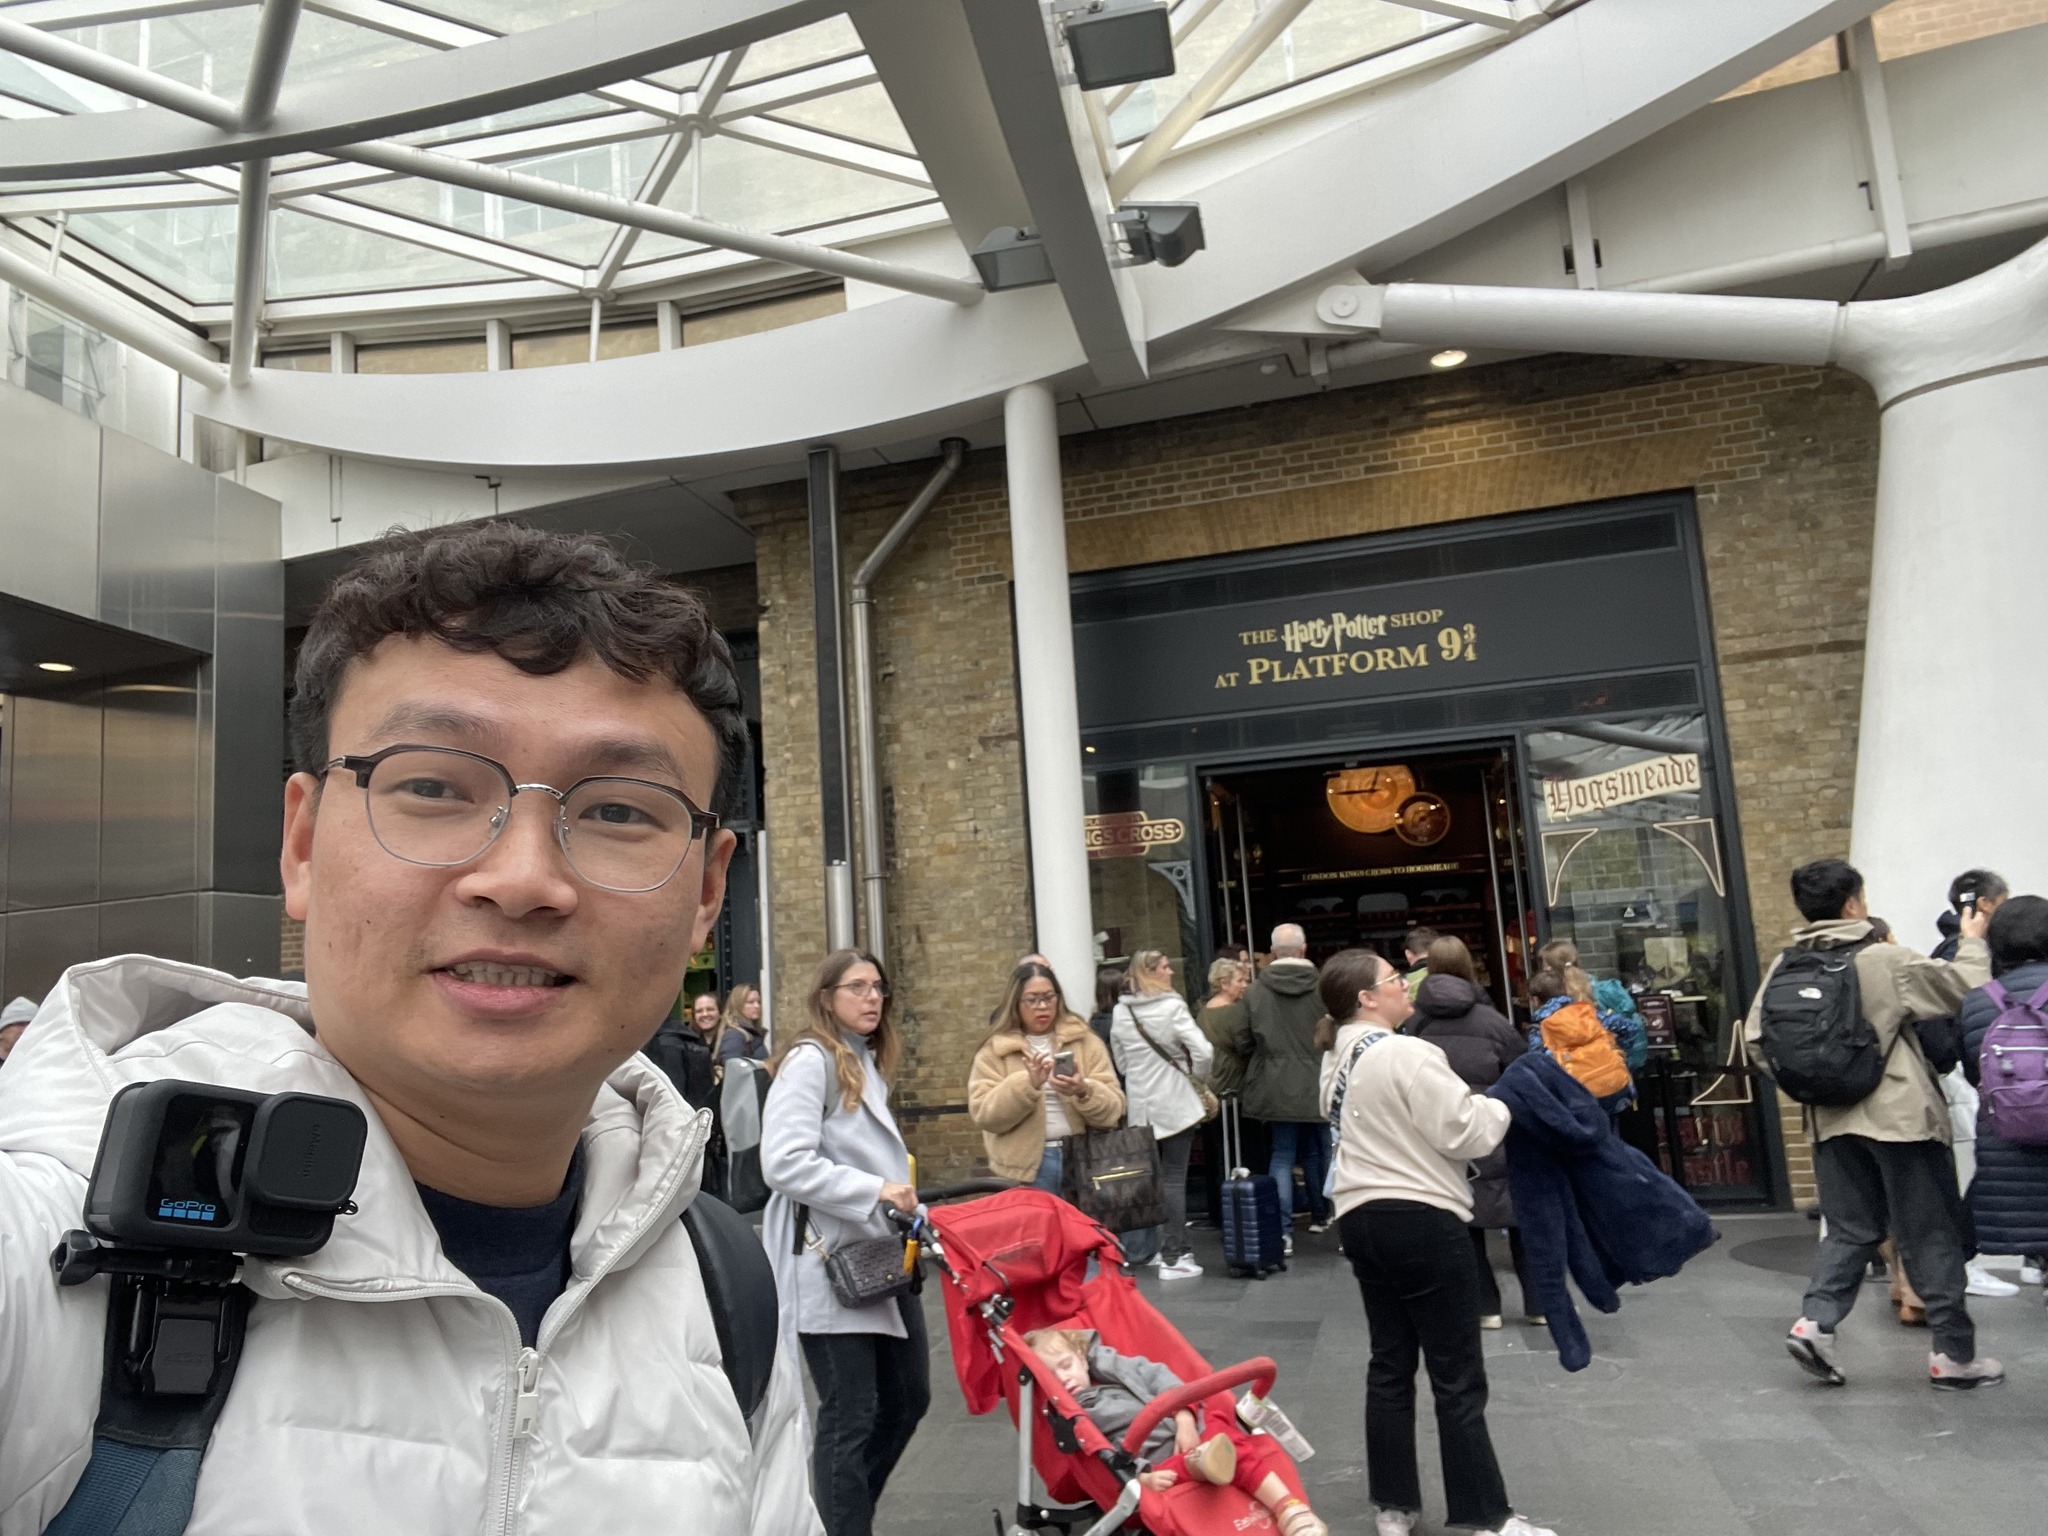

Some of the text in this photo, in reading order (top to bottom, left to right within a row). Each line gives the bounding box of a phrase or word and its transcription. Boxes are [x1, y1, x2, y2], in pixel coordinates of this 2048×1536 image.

[1238, 608, 1444, 653] THE Harry Potter SHOP
[1214, 672, 1240, 689] AT
[1247, 643, 1429, 685] PLATFORM
[1547, 755, 1698, 814] Hogsmeade
[161, 1198, 216, 1212] GoPro
